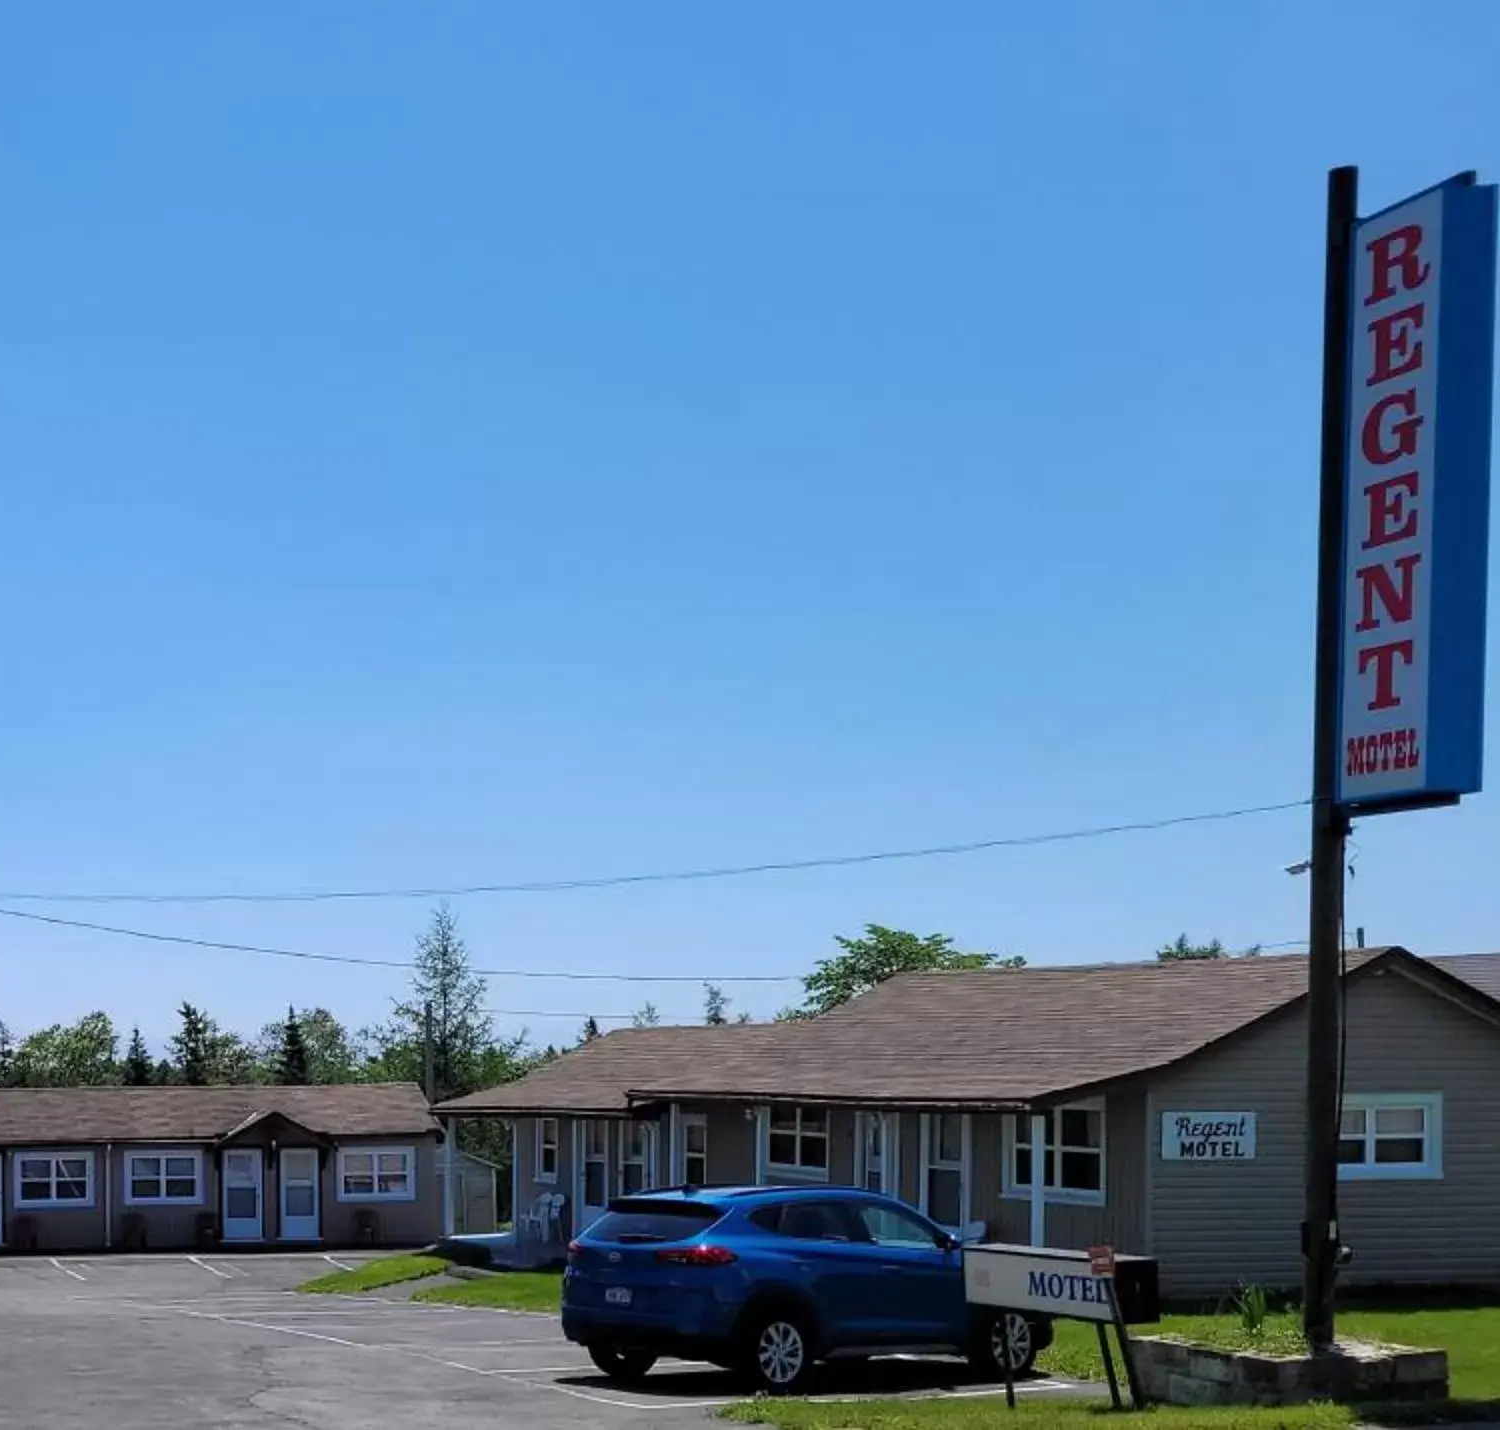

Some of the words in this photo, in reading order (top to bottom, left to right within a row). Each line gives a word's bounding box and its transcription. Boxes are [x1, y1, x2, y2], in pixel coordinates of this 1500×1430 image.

[1356, 222, 1430, 711] REGENT
[1346, 728, 1419, 776] MOTEL
[1175, 1115, 1245, 1142] Regent
[1180, 1141, 1245, 1157] MOTEL
[1028, 1271, 1111, 1305] MOTEL
